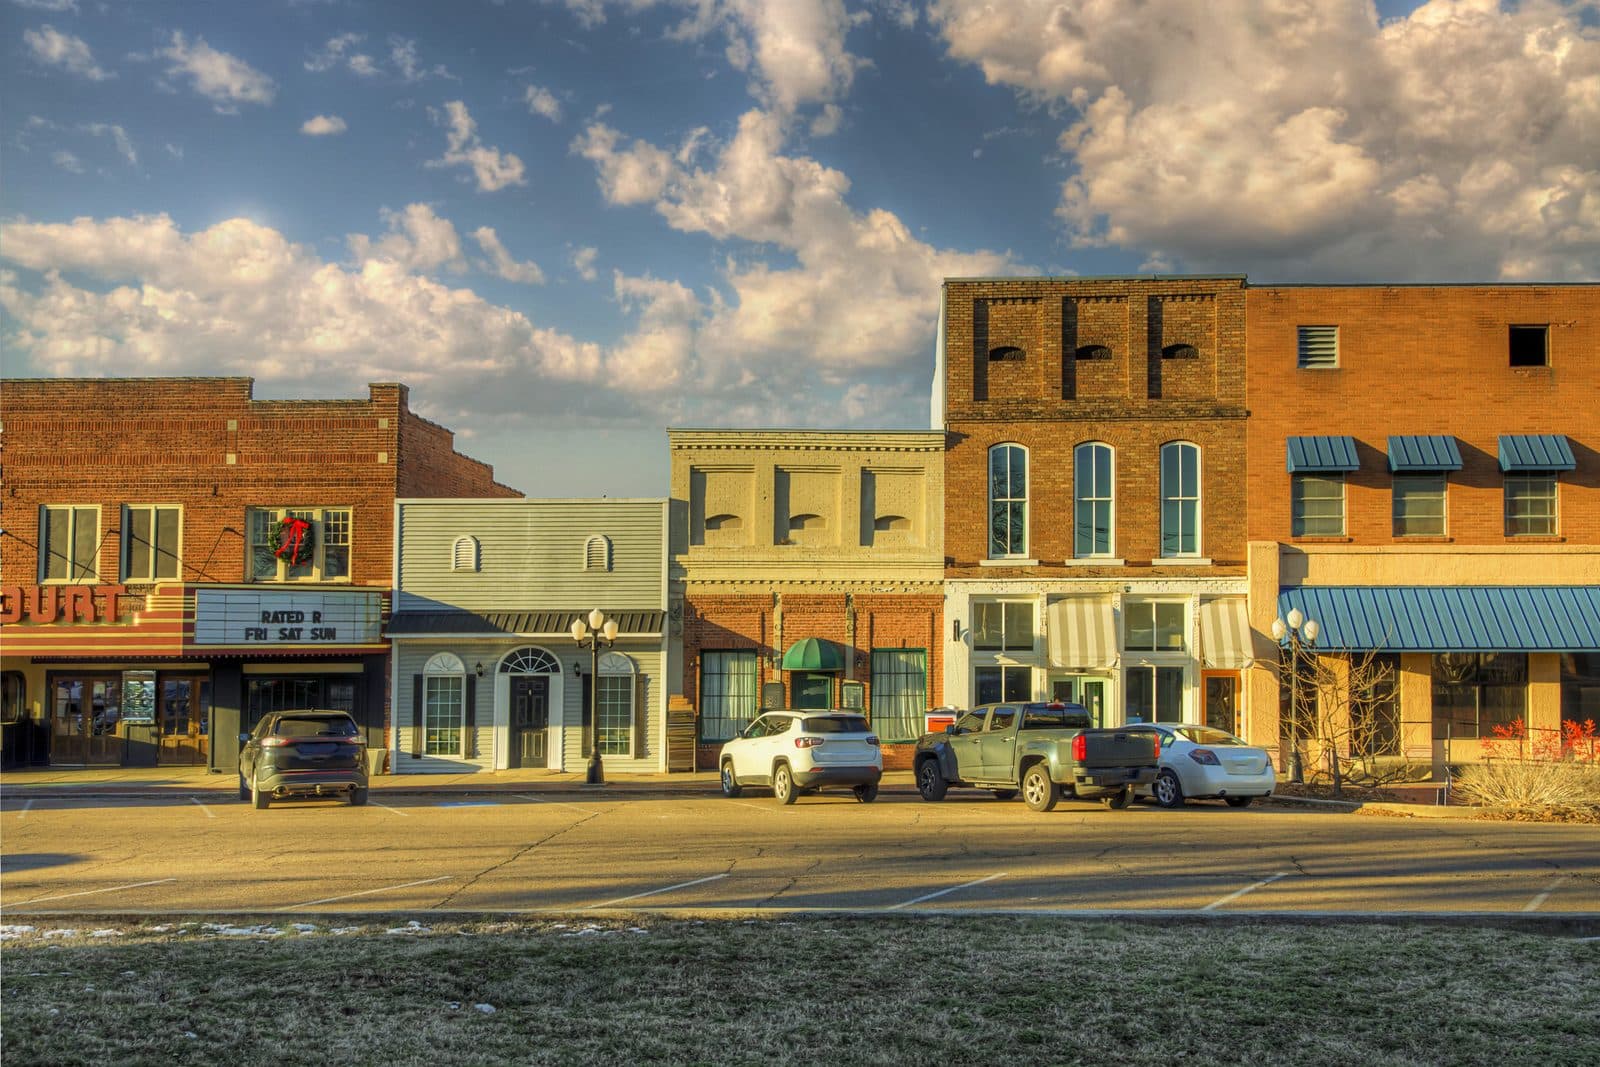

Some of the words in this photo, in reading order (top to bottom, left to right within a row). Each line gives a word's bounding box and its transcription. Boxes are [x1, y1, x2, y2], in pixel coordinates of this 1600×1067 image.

[262, 611, 304, 623] RATED
[312, 611, 321, 623] R
[245, 628, 267, 640] FRI
[279, 628, 303, 640] SAT
[311, 628, 336, 640] SUN
